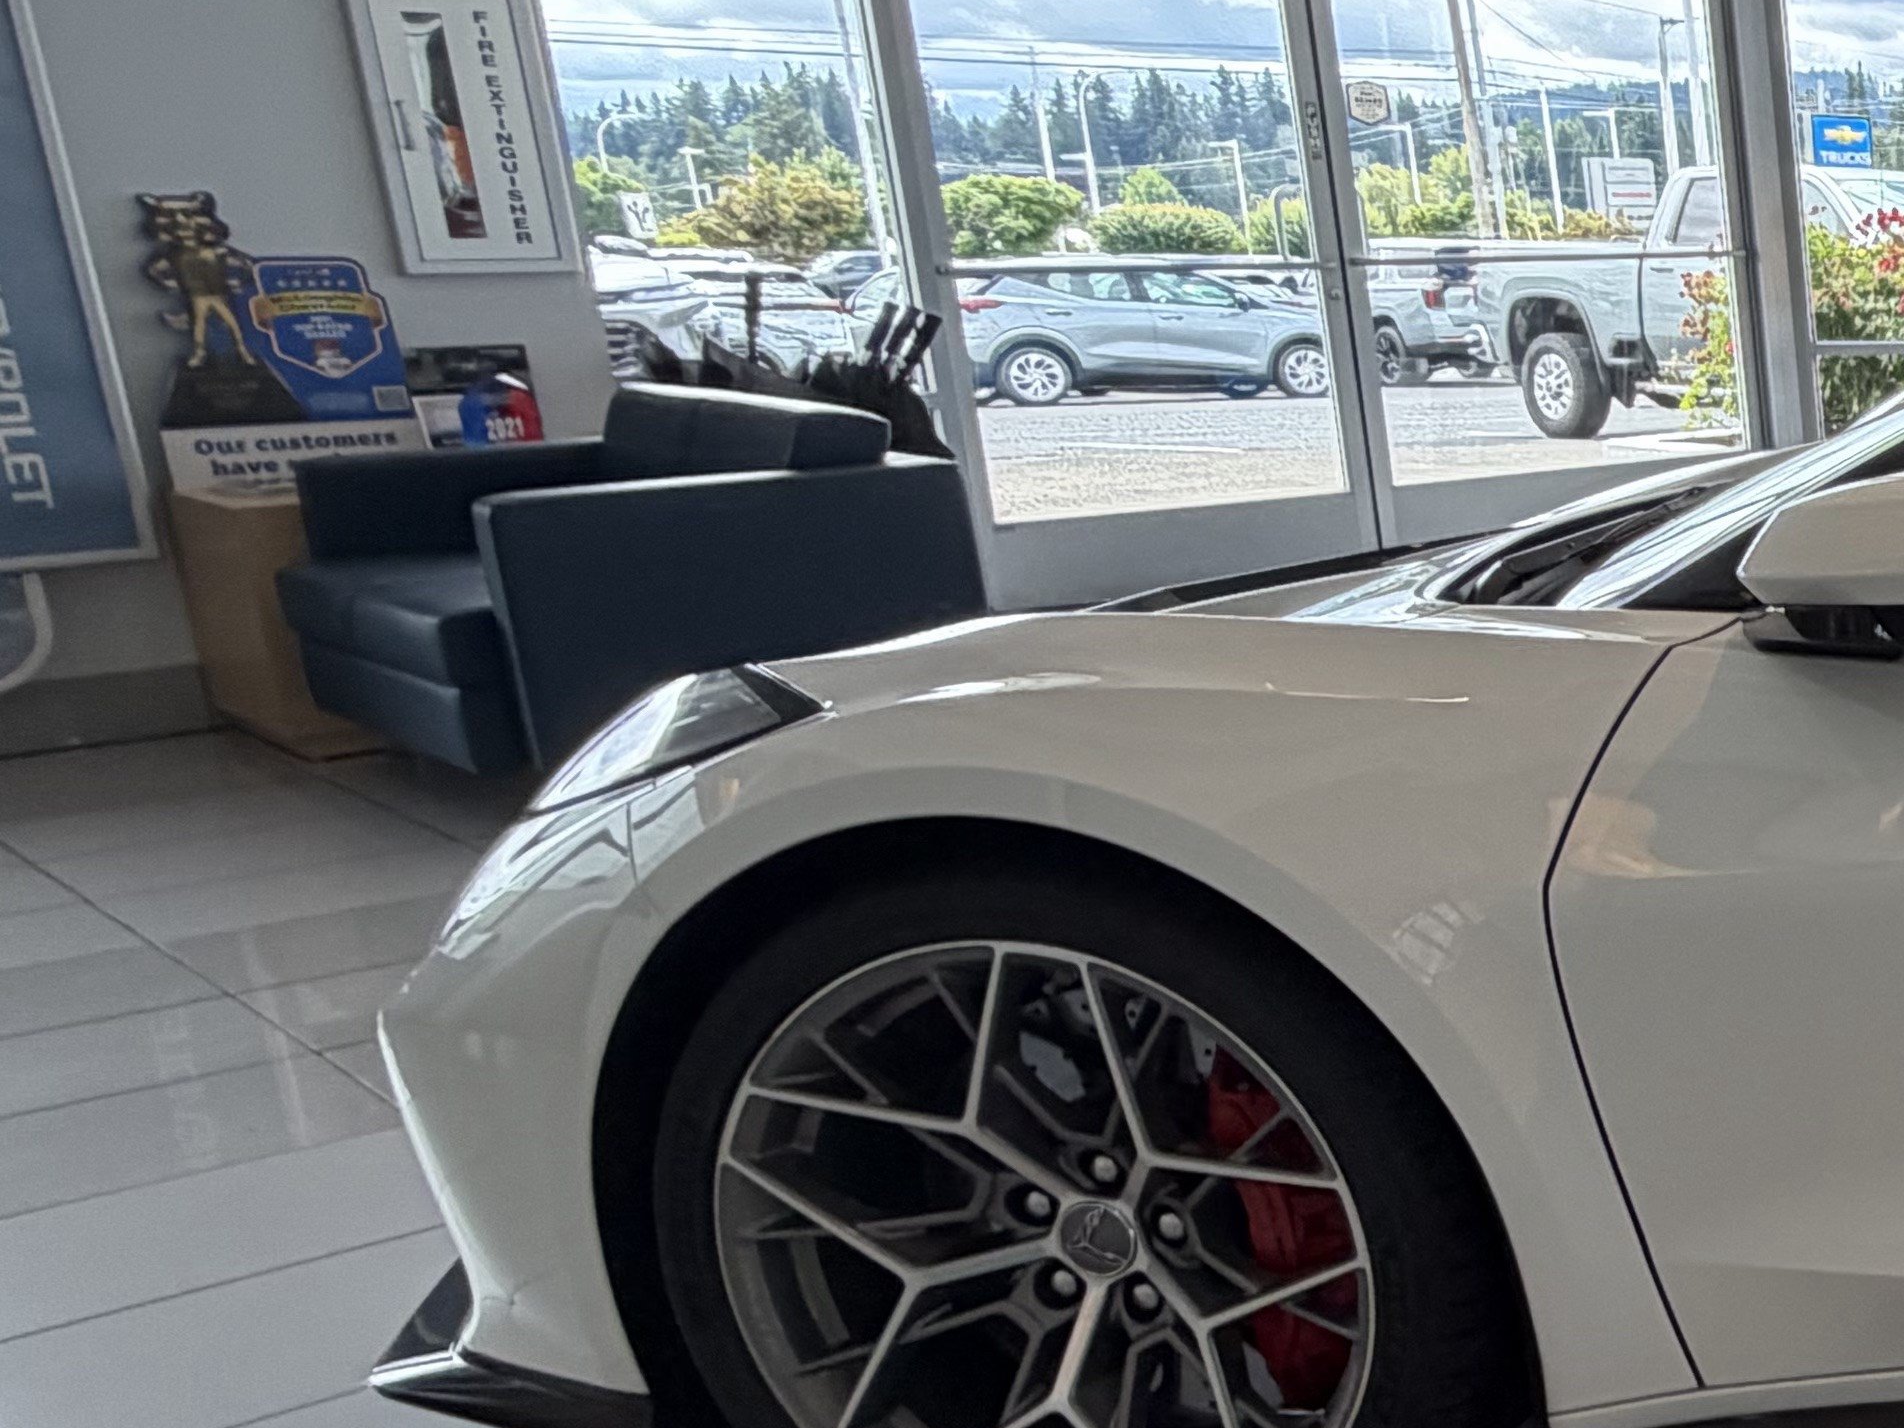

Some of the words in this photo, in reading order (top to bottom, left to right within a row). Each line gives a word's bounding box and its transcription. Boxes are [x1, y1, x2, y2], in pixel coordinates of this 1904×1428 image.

[472, 10, 497, 68] FIRE
[485, 75, 533, 245] EXTINGUISHER
[485, 416, 526, 442] 2021
[194, 438, 246, 456] Our
[255, 431, 399, 452] customers
[210, 458, 280, 476] have
